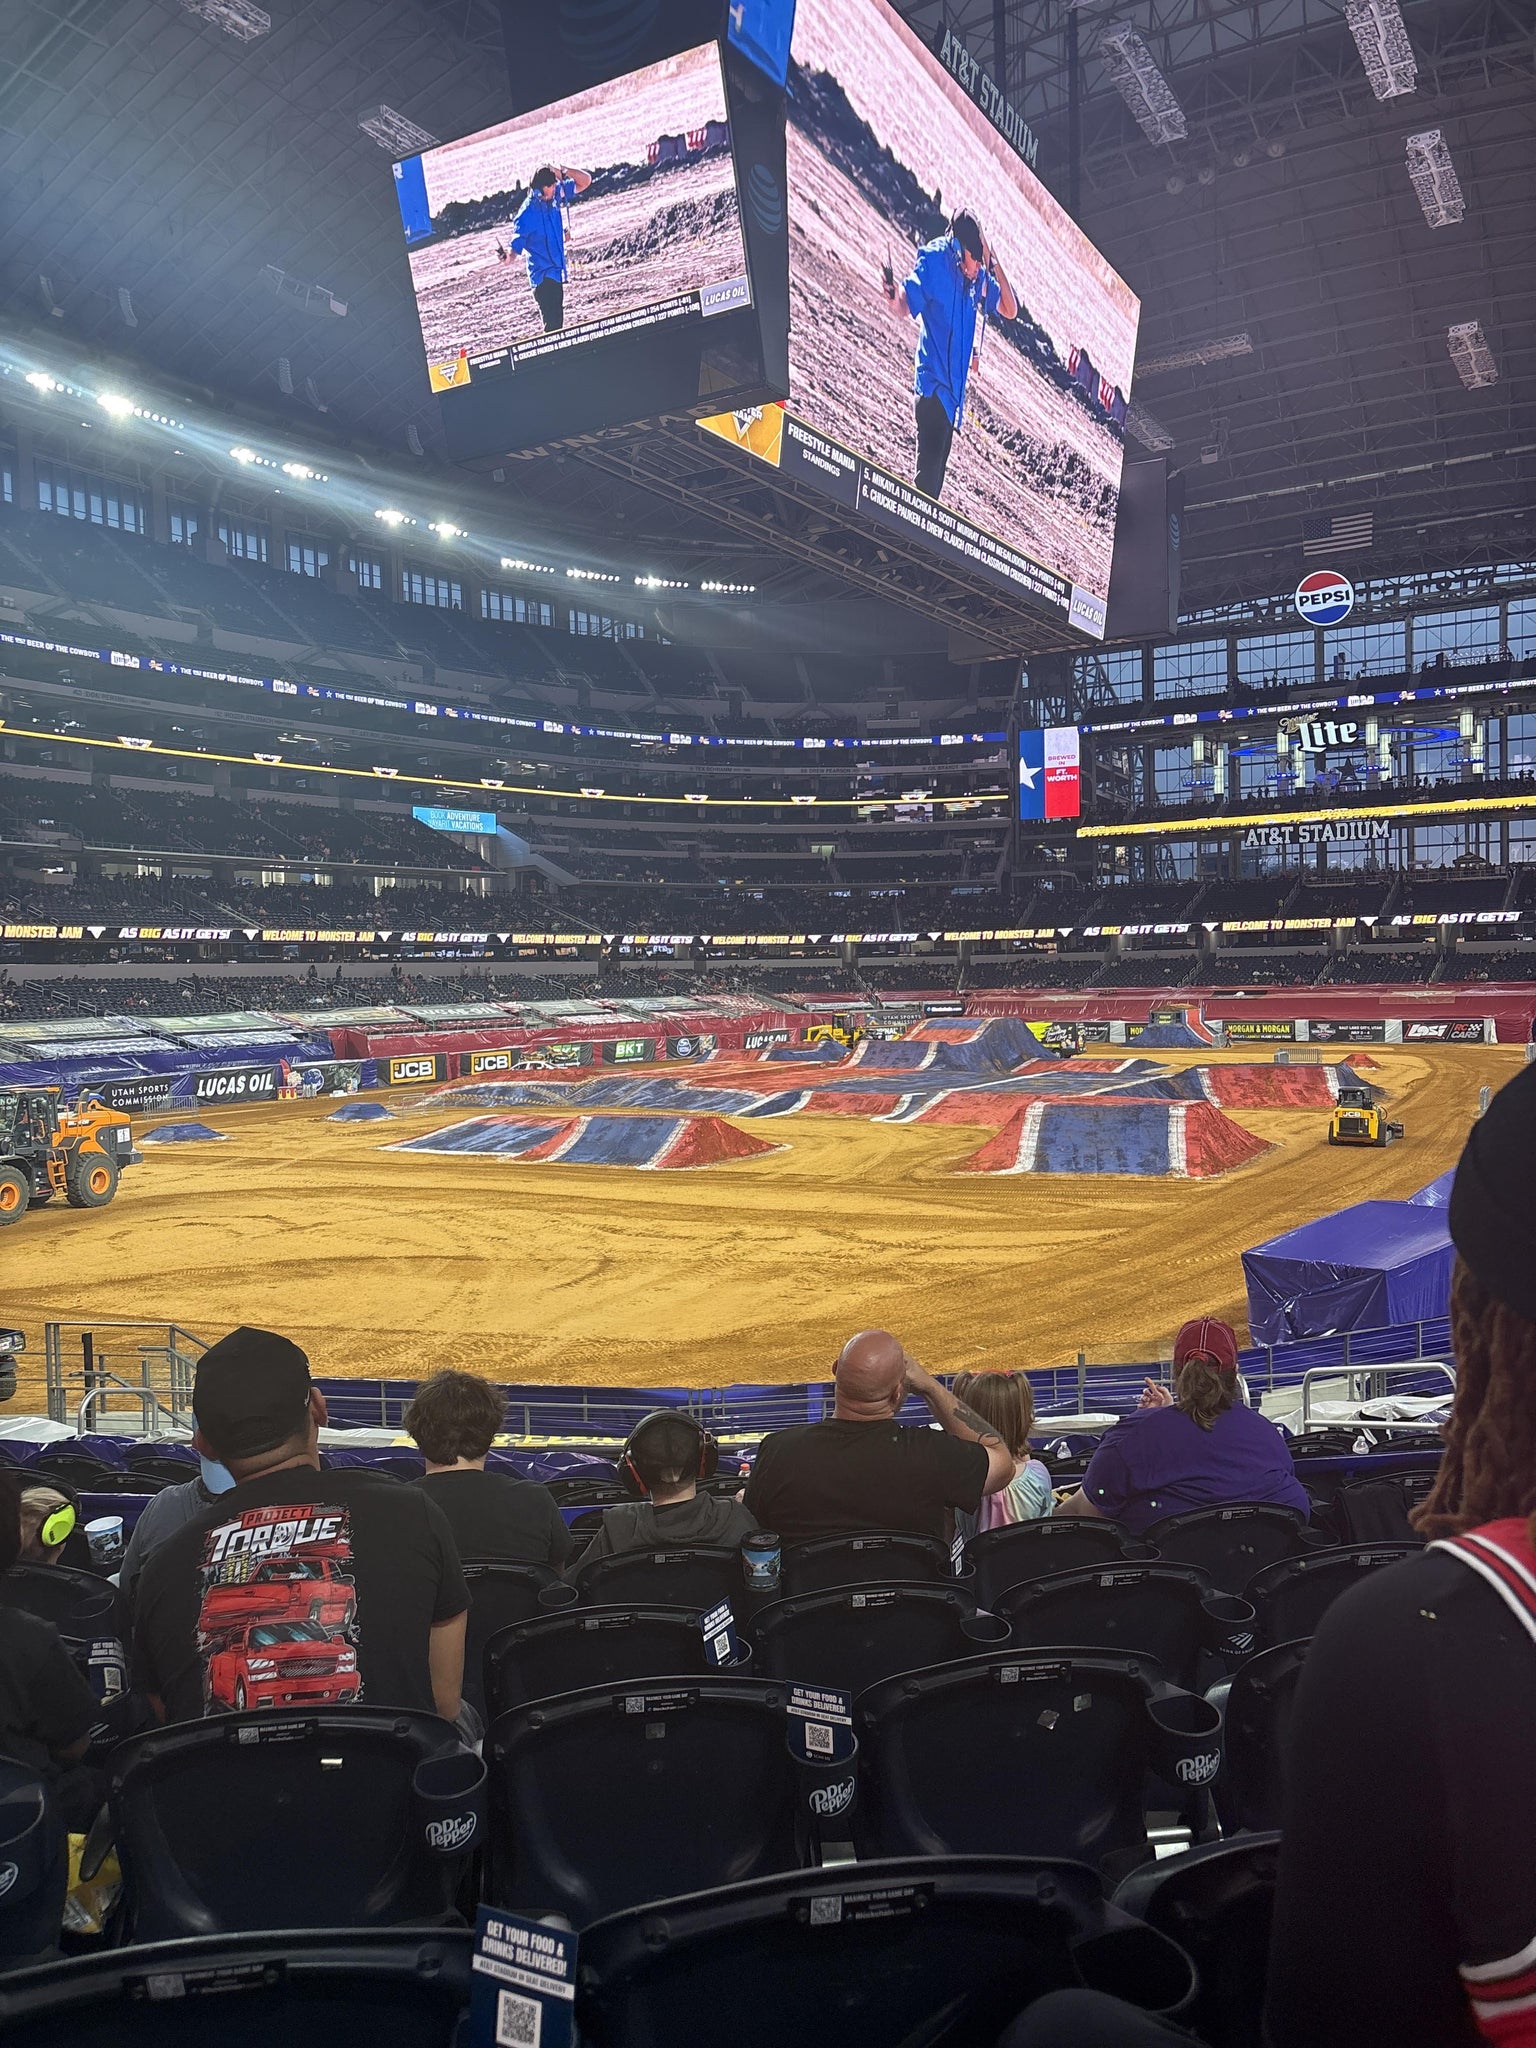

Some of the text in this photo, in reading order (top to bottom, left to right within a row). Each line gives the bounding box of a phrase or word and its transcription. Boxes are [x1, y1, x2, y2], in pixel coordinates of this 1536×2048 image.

[940, 29, 1039, 168] AT&T STADIUM
[705, 285, 745, 306] LUCAS OIL
[506, 404, 725, 461] WINSTAR
[788, 422, 855, 472] FREESTYLE MANIA
[802, 449, 841, 477] STANDINGS
[864, 467, 871, 480] 5.
[872, 472, 900, 497] MIKAYLA
[901, 488, 931, 516] TULACHKA
[932, 508, 938, 519] &
[938, 511, 957, 529] SCOTT
[957, 521, 979, 542] MURRAY
[979, 535, 996, 552] (TEAM
[1299, 589, 1350, 607] PEPSI
[1072, 599, 1103, 625] LUCAS OIL
[0, 634, 14, 643] THE
[27, 639, 44, 648] BEER
[55, 644, 68, 653] THE
[69, 647, 100, 658] COWBOYS
[1297, 721, 1357, 752] Lite
[1047, 754, 1076, 762] BREWED
[1047, 773, 1077, 782] WORTH
[430, 811, 481, 822] BOOK ADVENTURE
[451, 821, 484, 831] VACATIONS
[1245, 820, 1390, 847] AT&T STADIUM
[1222, 917, 1356, 931] WELCOME TO MONSTER JAM
[1391, 911, 1522, 925] AS BIG AS IT GETS!
[4, 926, 83, 939] MONSTER JAM
[119, 927, 232, 939] AS BIG AS IT GETS!
[262, 930, 375, 942] WELCOME TO MONSTER JAM
[401, 932, 487, 943] AS BIG AS IT GETS!
[943, 928, 1055, 941] WELCOME TO MONSTER JAM
[1083, 924, 1191, 936] AS BIG AS IT GETS!
[511, 934, 601, 945] WELCOME TO MONSTER JAM
[621, 935, 634, 945] AS
[634, 935, 648, 945] BIG
[649, 935, 660, 945] AS
[660, 935, 670, 945] IT
[712, 935, 805, 945] WELCOME TO MONSTER JAM
[830, 934, 844, 943] AS
[845, 934, 861, 943] BIG
[862, 934, 876, 943] AS
[876, 934, 889, 943] IT
[1228, 1024, 1290, 1033] MORGAN & MORGAN
[1451, 1031, 1479, 1039] CARS
[615, 1041, 643, 1058] BKT
[394, 1061, 432, 1078] JCB
[474, 1056, 508, 1071] JCB
[111, 1084, 169, 1097] UTAH SPORTS
[196, 1073, 275, 1097] LUCAS OIL
[111, 1094, 169, 1107] COMMISSION
[246, 1506, 307, 1525] PROJECT
[210, 1517, 342, 1562] TORQUE
[793, 1688, 804, 1696] GET
[805, 1690, 821, 1700] YOUR
[821, 1693, 837, 1704] FOOD
[791, 1696, 846, 1714] DRINKS DELIVERED!
[1176, 1755, 1219, 1782] Pepper
[1195, 1753, 1211, 1768] Dr
[826, 1781, 844, 1796] Dr
[809, 1781, 853, 1814] Pepper
[426, 1818, 473, 1847] Pepper
[442, 1817, 461, 1834] Dr
[487, 1919, 564, 1957] GET YOUR FOOD &
[482, 1936, 567, 1977] DRINKS DELIVERED!
